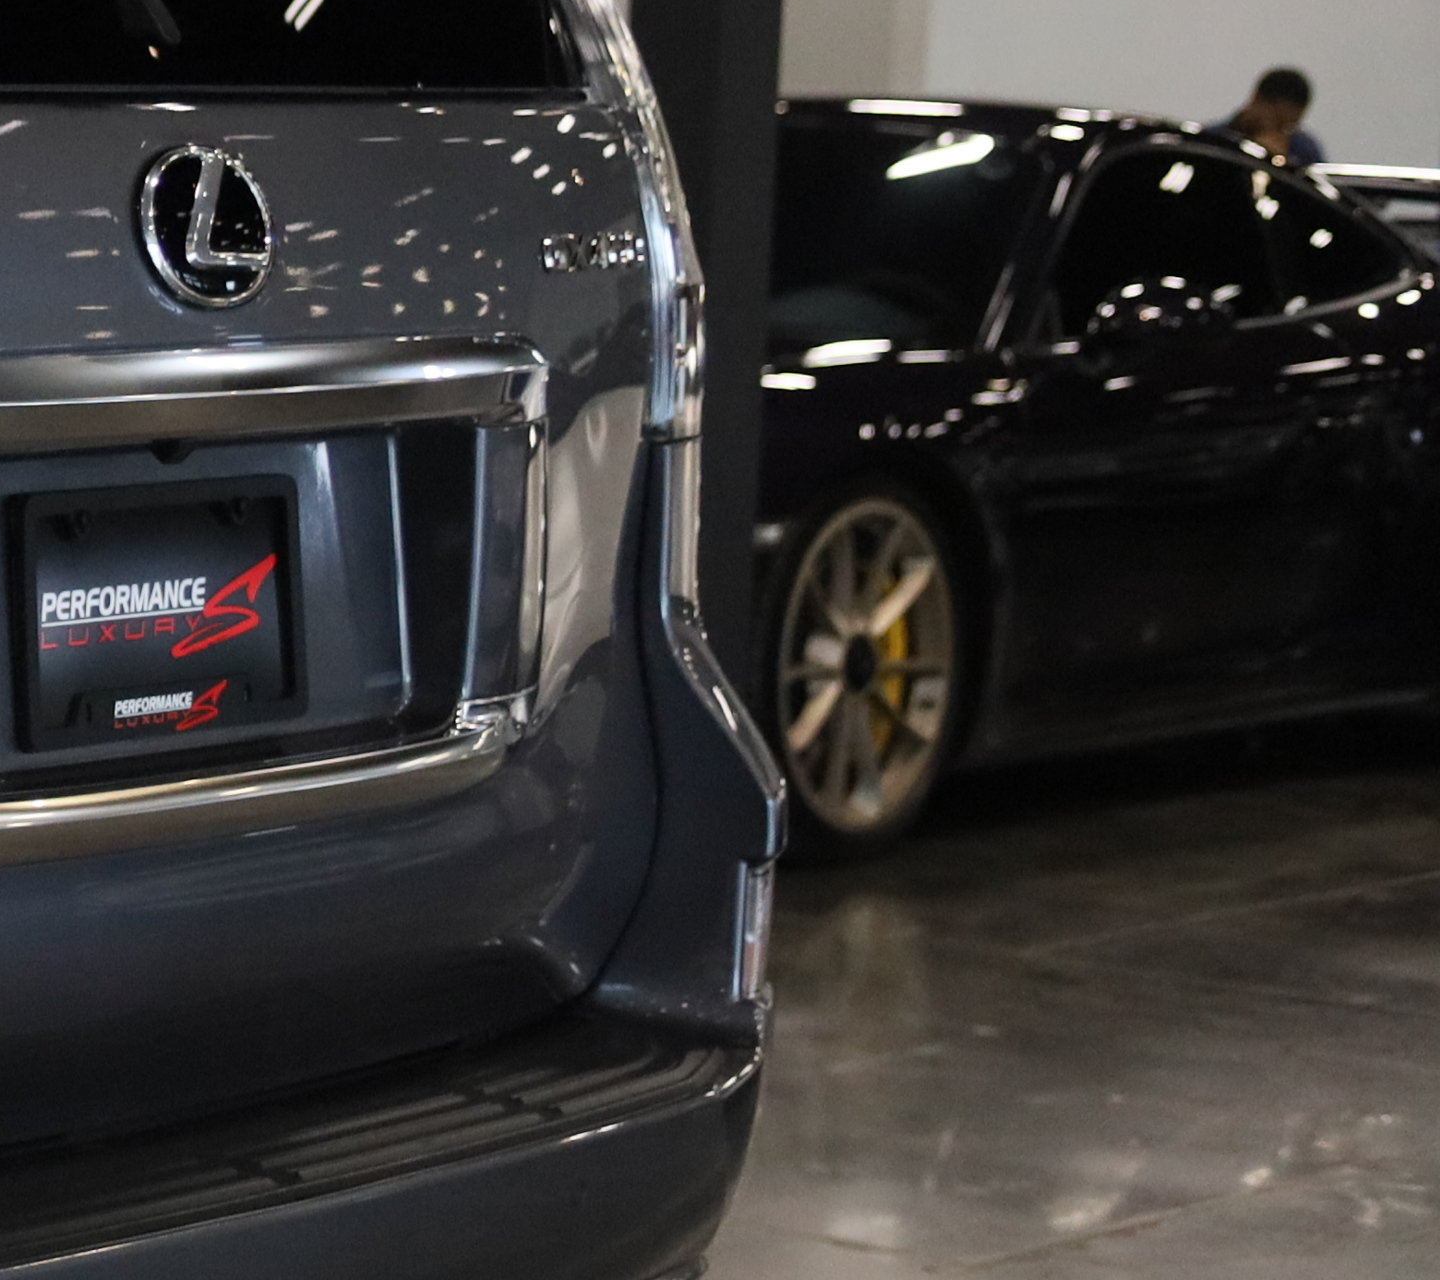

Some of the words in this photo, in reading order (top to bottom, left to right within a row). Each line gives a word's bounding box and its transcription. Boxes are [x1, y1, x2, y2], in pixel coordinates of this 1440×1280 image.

[41, 577, 207, 622] PERFORMANCE
[39, 616, 201, 650] LUXURY
[114, 691, 194, 716] PERFORMANCE
